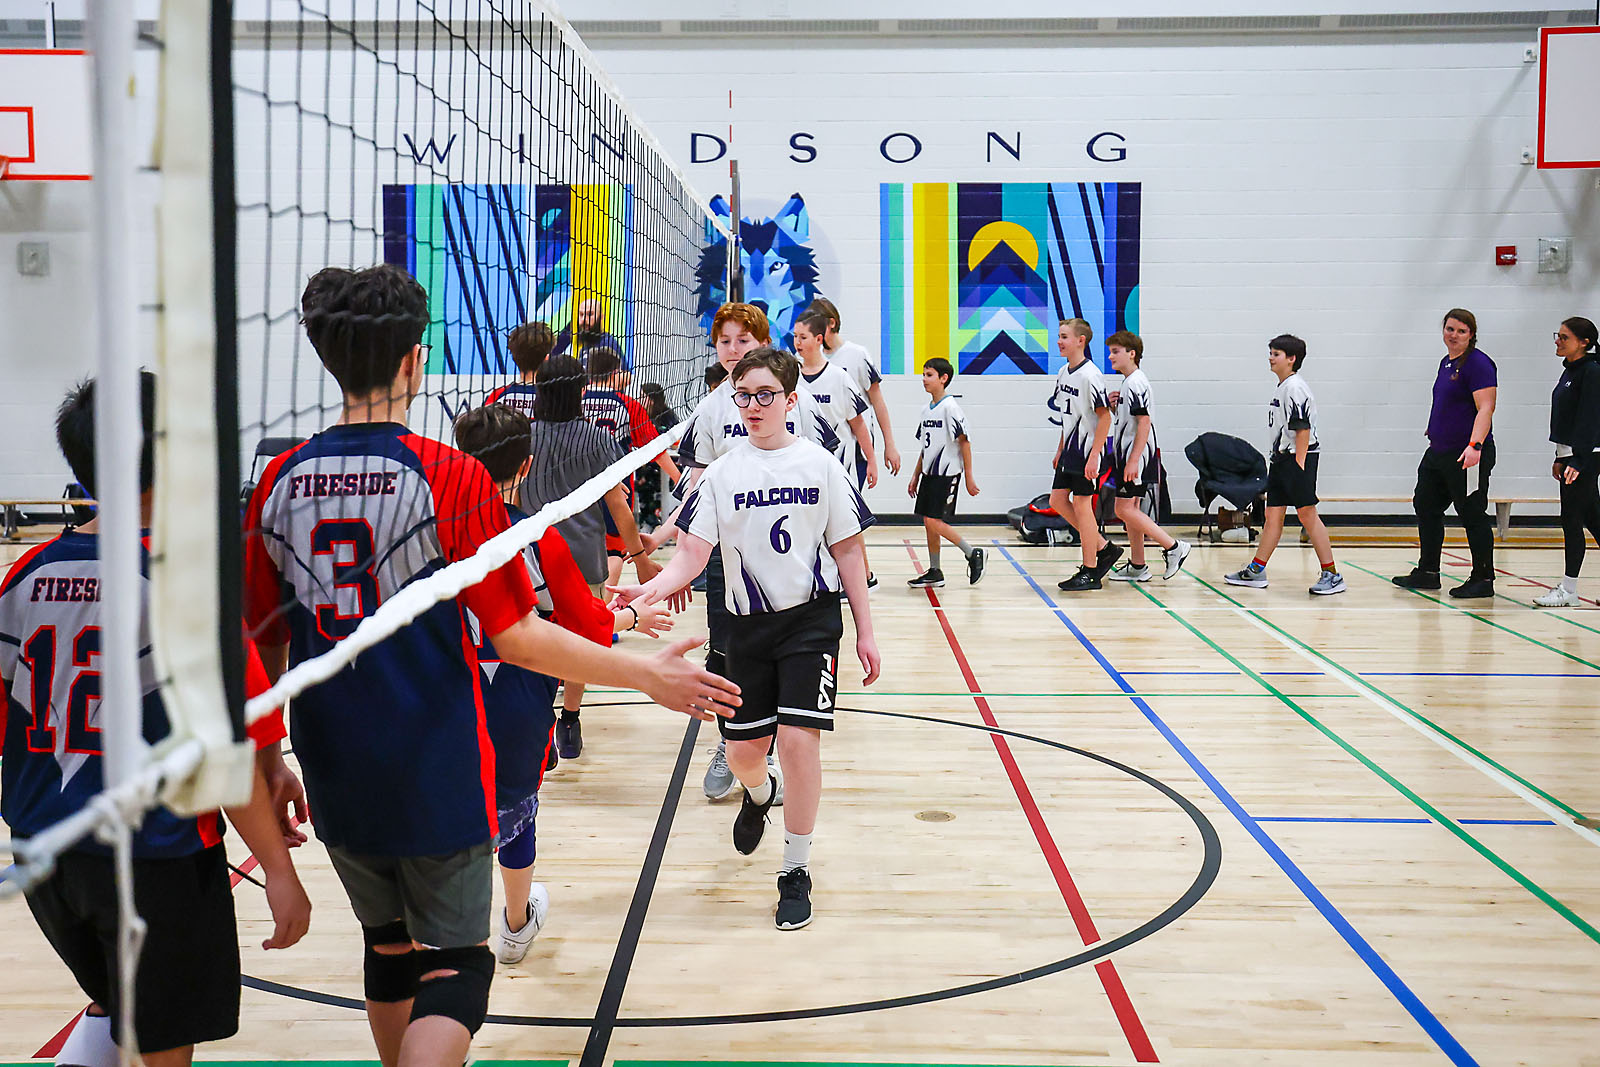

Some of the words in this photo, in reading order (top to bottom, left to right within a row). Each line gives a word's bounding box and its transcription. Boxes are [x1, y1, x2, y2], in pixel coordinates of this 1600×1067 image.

[723, 421, 795, 439] FALS
[290, 472, 398, 500] FIRESIDE
[733, 487, 820, 511] FALCONS
[769, 514, 792, 554] 6
[30, 577, 102, 602] FIRES
[310, 517, 382, 641] 3
[817, 653, 836, 710] FILA
